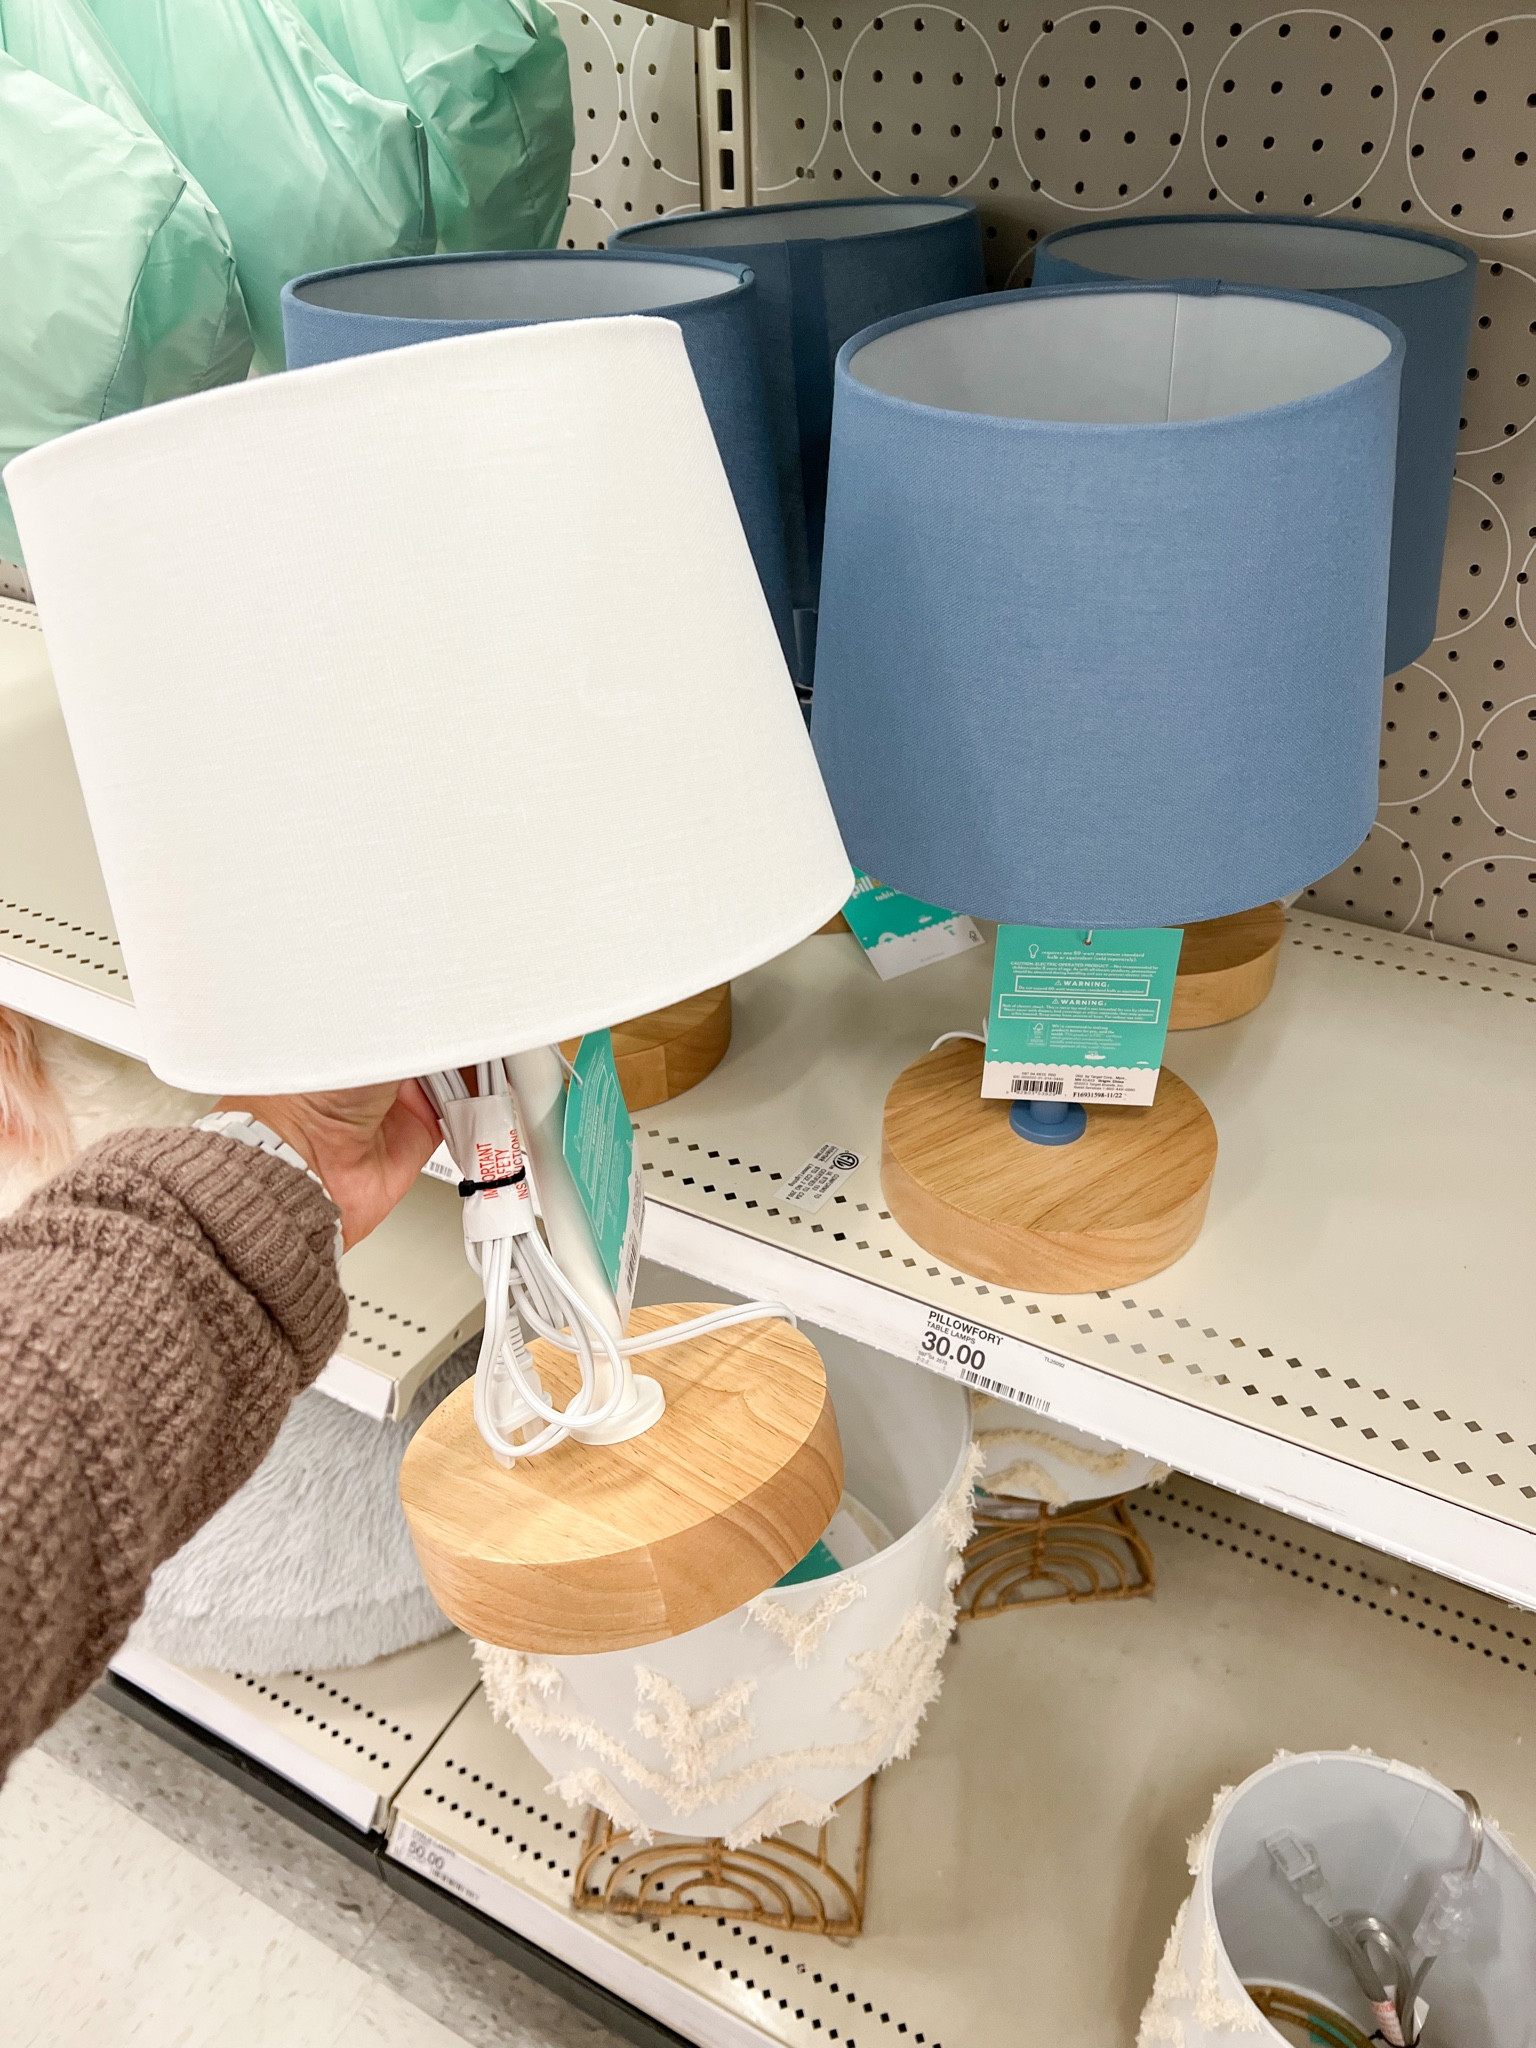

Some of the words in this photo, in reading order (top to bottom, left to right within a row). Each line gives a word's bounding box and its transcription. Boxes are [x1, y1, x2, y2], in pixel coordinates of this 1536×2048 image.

[1063, 980, 1110, 988] WARNING:
[476, 1143, 499, 1200] IMORTANT
[926, 1320, 950, 1335] TABLE
[950, 1330, 976, 1345] LAMPS
[928, 1310, 1004, 1346] PILLOWFORT
[921, 1331, 986, 1371] 30.00
